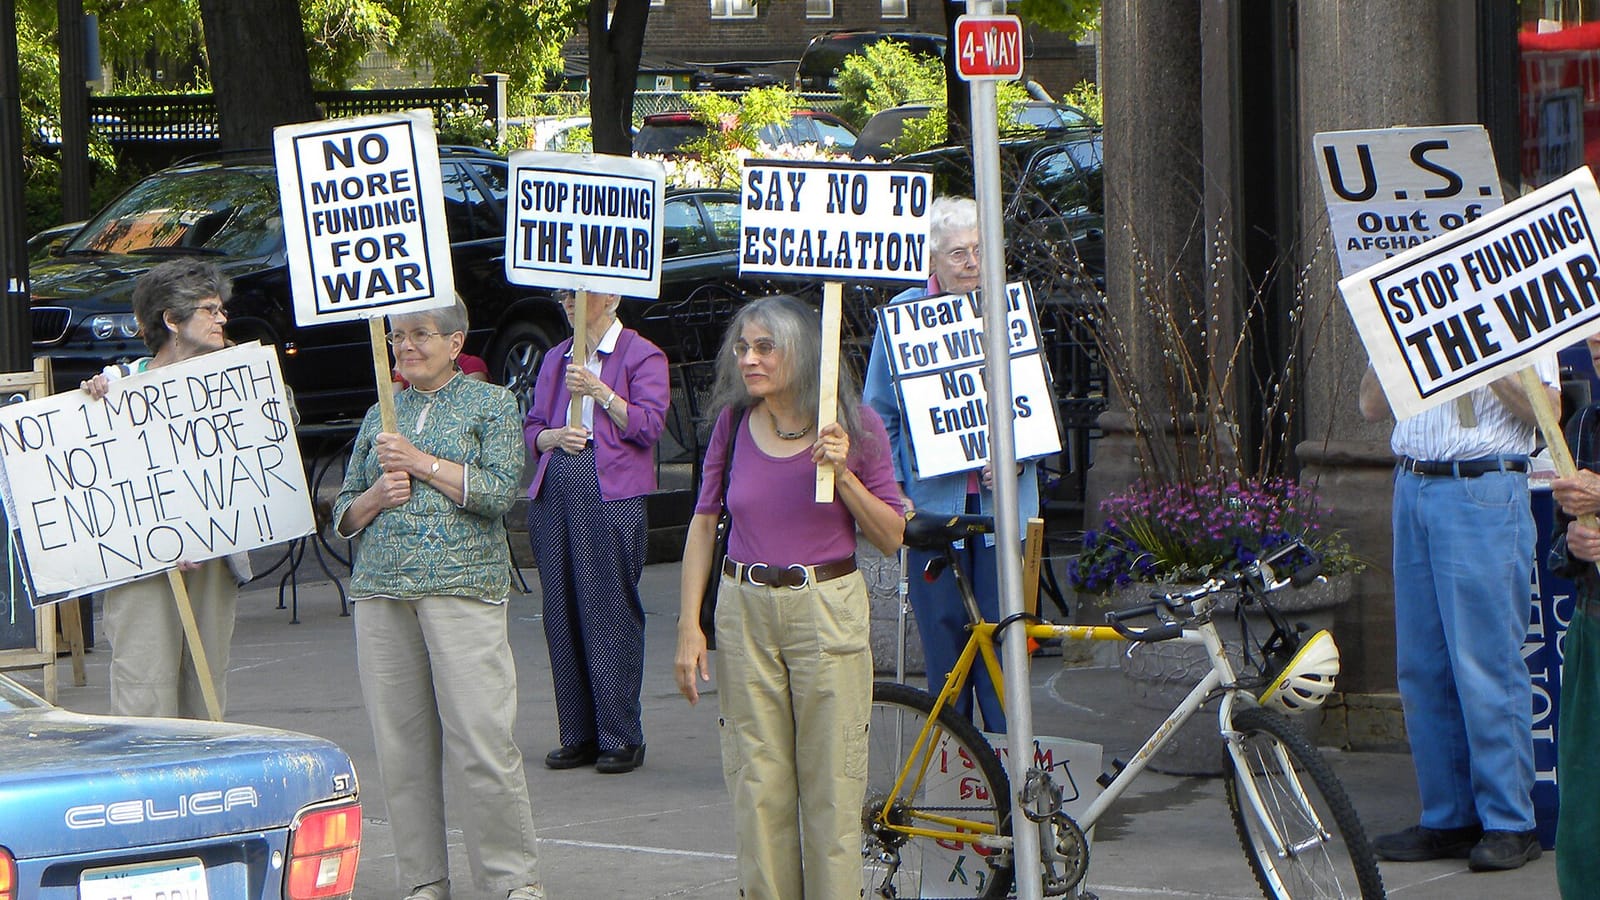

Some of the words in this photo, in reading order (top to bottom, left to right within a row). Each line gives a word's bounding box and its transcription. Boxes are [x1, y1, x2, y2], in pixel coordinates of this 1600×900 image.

[962, 31, 1017, 67] 4-WAY
[322, 133, 389, 171] NO
[1323, 140, 1492, 201] U.S.
[311, 169, 411, 204] MORE
[521, 180, 569, 213] STOP
[573, 184, 651, 220] FUNDING
[747, 170, 806, 212] SAY
[826, 173, 868, 215] NO
[890, 176, 927, 217] TO
[312, 198, 417, 236] FUNDING
[1357, 210, 1430, 233] Out
[1439, 204, 1482, 230] of
[331, 232, 410, 267] FOR
[520, 219, 573, 264] THE
[580, 224, 650, 270] WAR
[743, 227, 925, 272] ESCALATION
[322, 262, 425, 304] WAR
[1387, 263, 1460, 325] STOP
[1461, 205, 1585, 292] FUNDING
[888, 308, 900, 335] 7
[905, 298, 963, 331] Year
[1405, 304, 1502, 381] THE
[1494, 253, 1600, 343] WAR
[898, 341, 938, 370] For
[940, 371, 975, 400] No
[0, 410, 60, 456] NOT
[78, 404, 97, 439] 1
[103, 379, 184, 431] MORE
[187, 361, 276, 412] DEATH
[929, 395, 1032, 435] Endls
[45, 439, 117, 492] NOT
[138, 430, 160, 470] 1
[168, 409, 253, 464] MORE
[261, 398, 288, 443] $
[32, 488, 116, 551] END
[112, 470, 182, 527] THE
[183, 444, 297, 511] WAR
[333, 773, 350, 791] ST
[65, 786, 258, 829] CELICA
